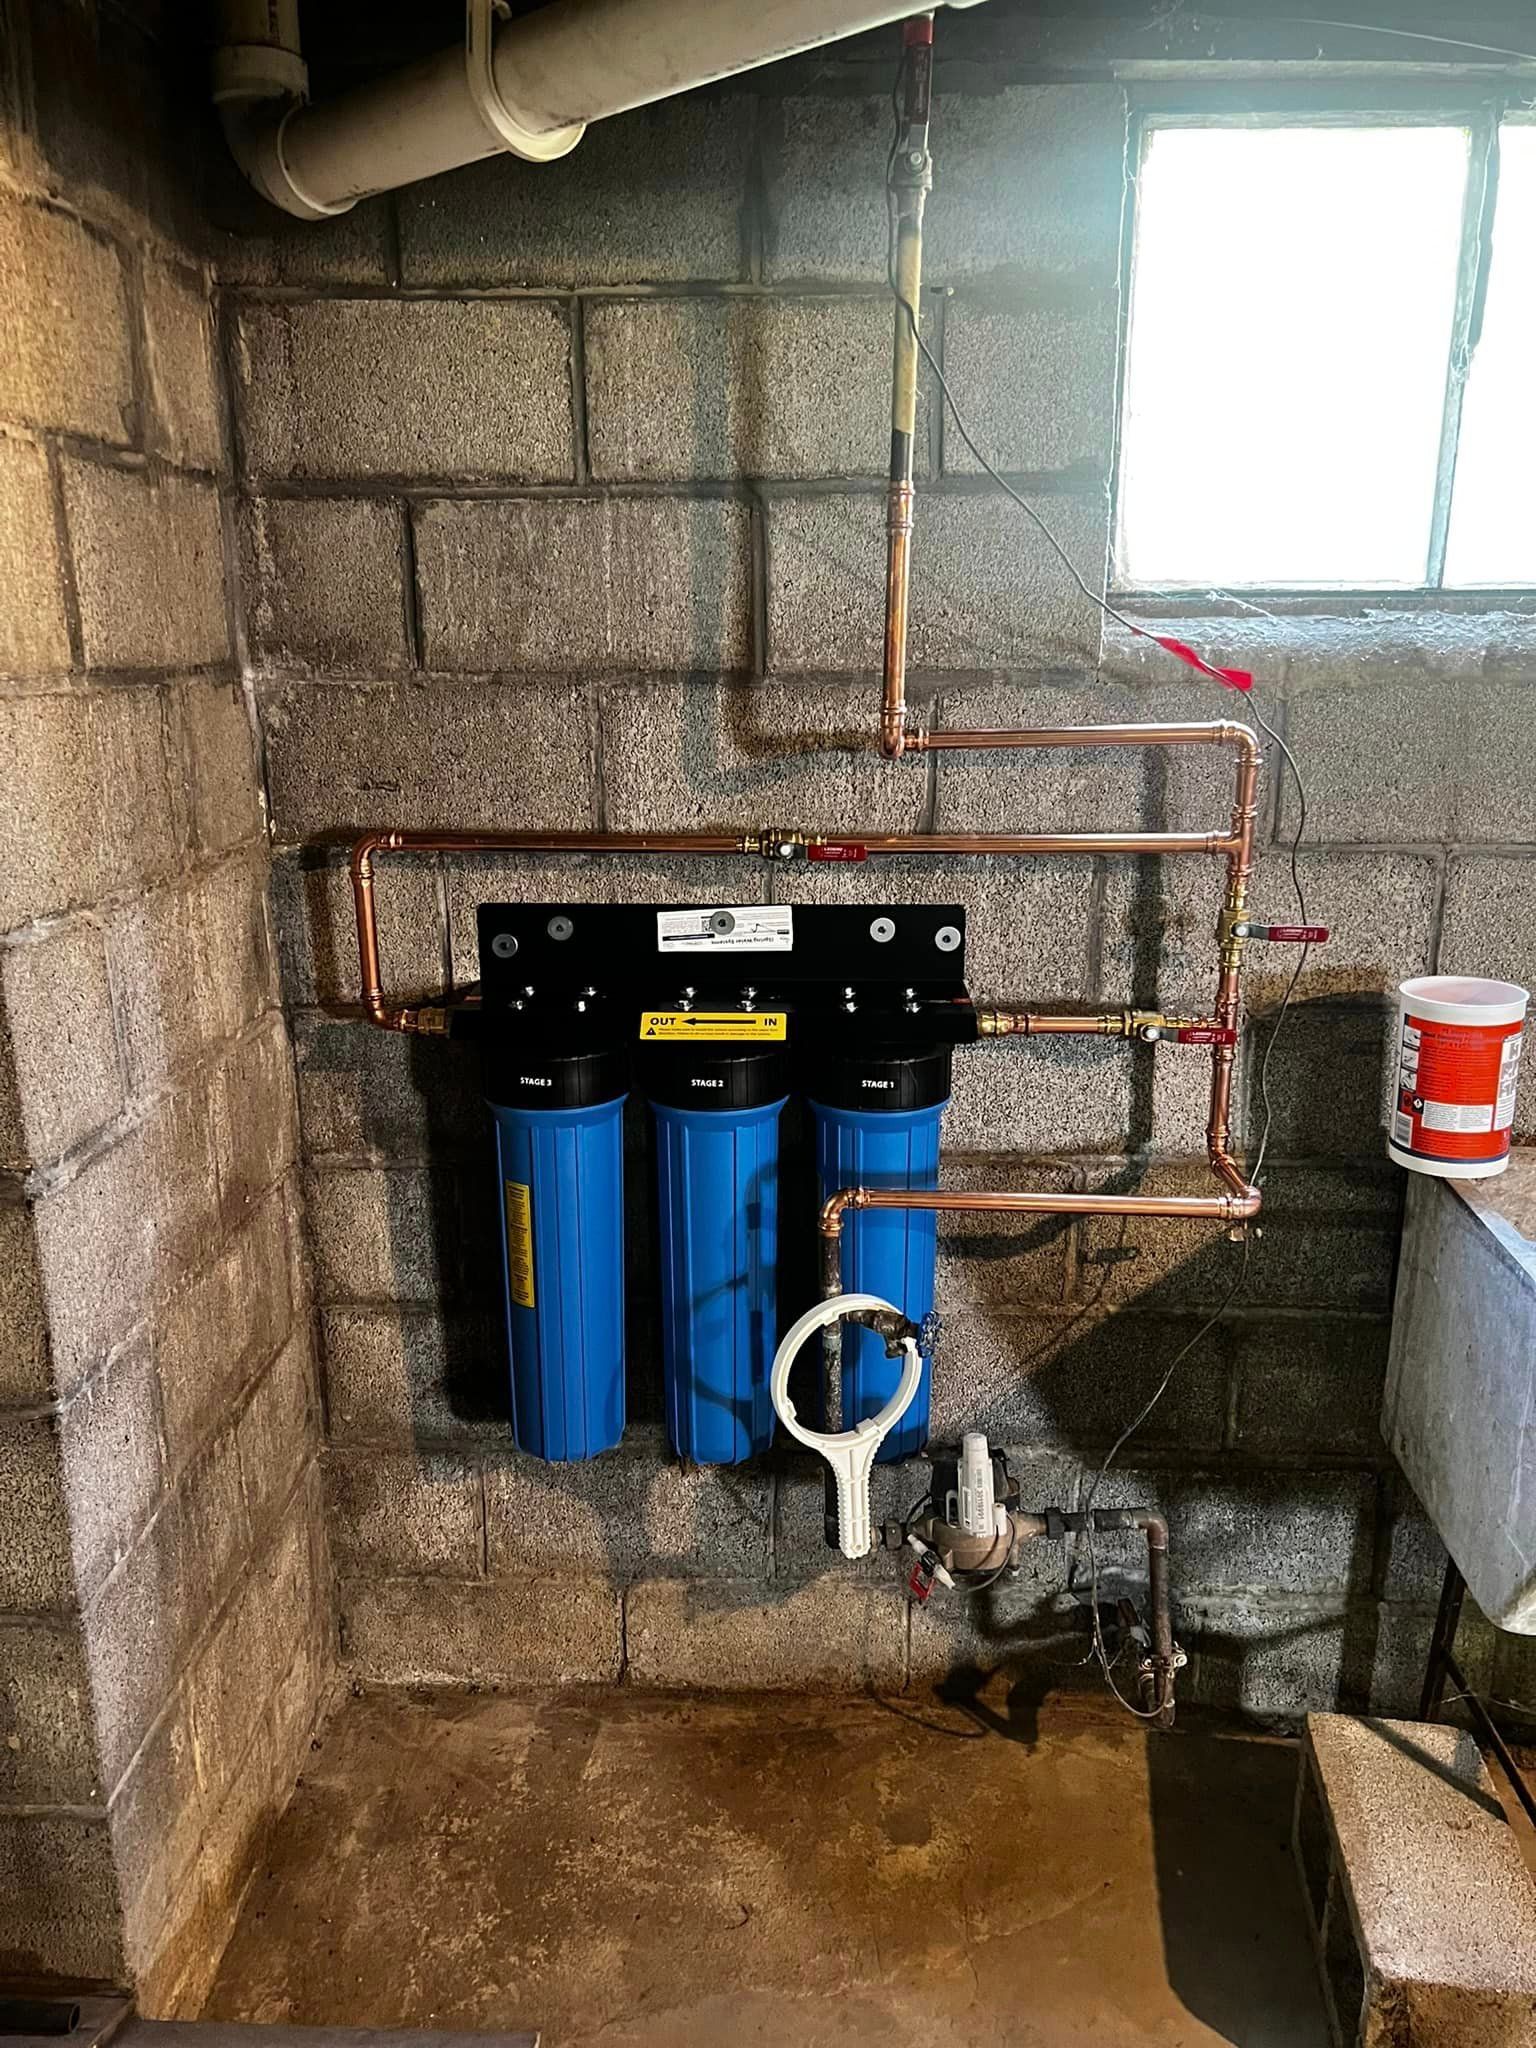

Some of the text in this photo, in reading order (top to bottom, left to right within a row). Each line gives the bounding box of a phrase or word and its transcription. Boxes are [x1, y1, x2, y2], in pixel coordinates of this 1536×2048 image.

[650, 1017, 777, 1026] OUT IN
[520, 1076, 552, 1087] STAGE 3
[690, 1079, 724, 1088] STAGE 2
[861, 1080, 895, 1089] STAGE 1
